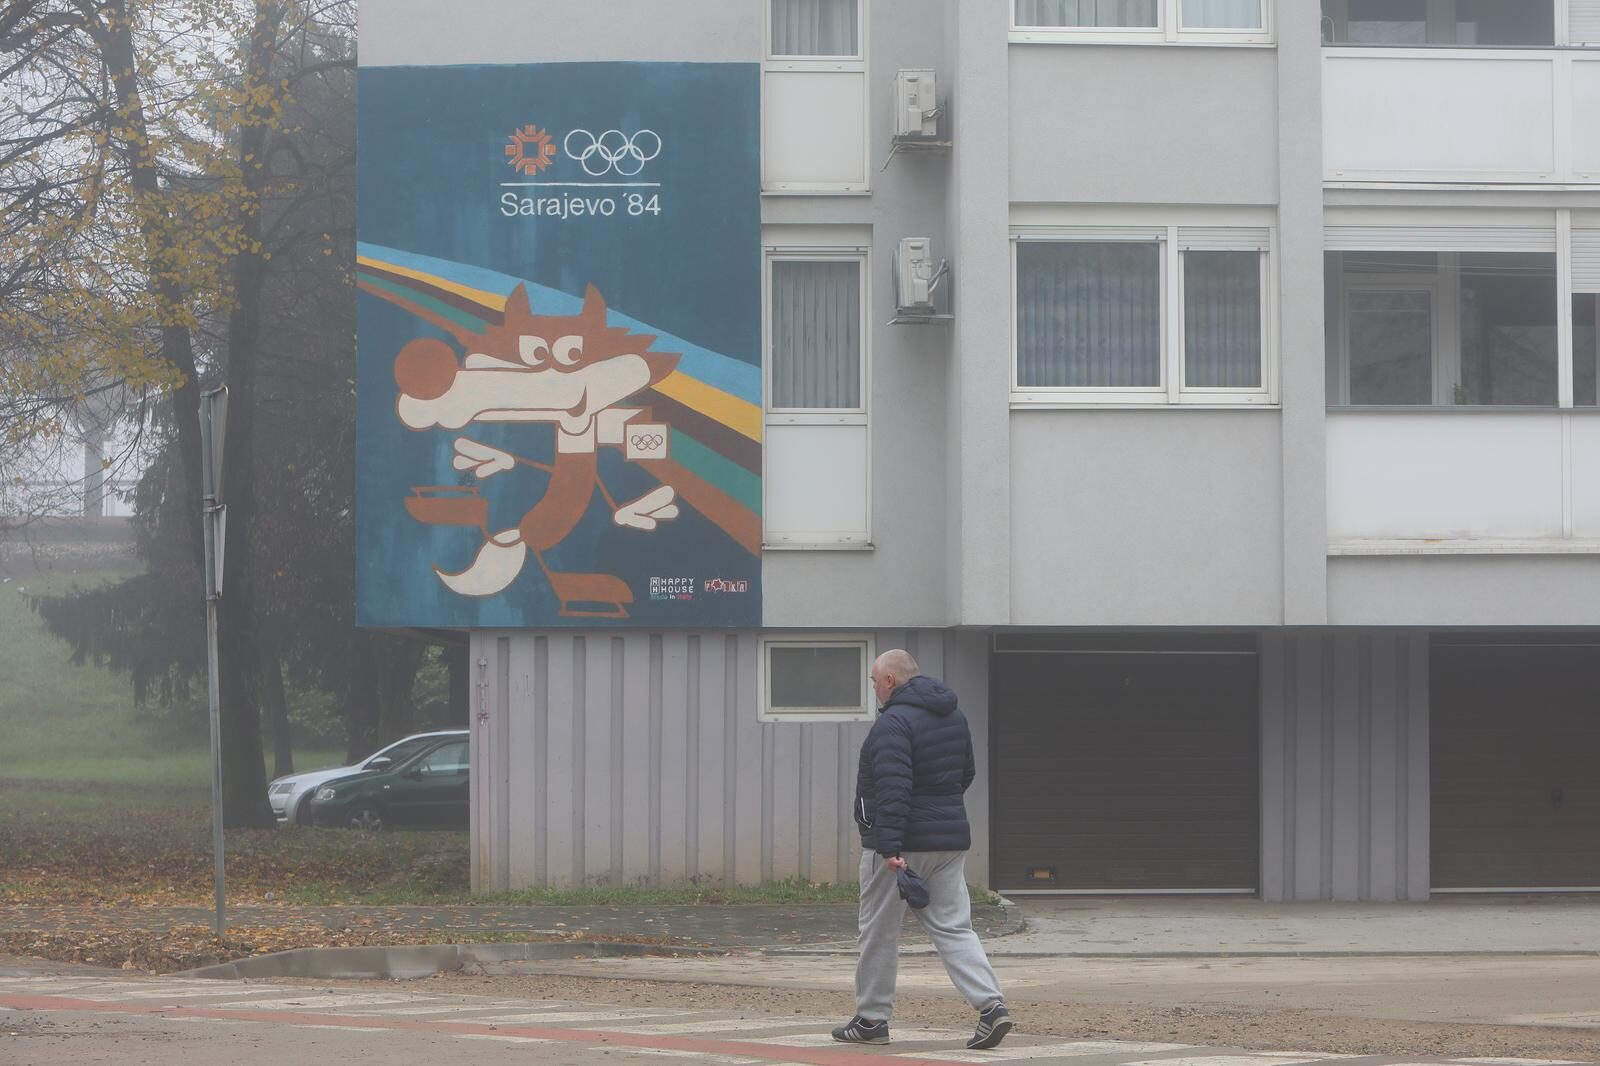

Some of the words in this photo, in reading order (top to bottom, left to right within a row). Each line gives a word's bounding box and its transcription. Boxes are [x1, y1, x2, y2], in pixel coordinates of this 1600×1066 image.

[500, 192, 616, 220] Sarajevo
[660, 577, 695, 585] HAPPY
[660, 585, 695, 593] HOUSE
